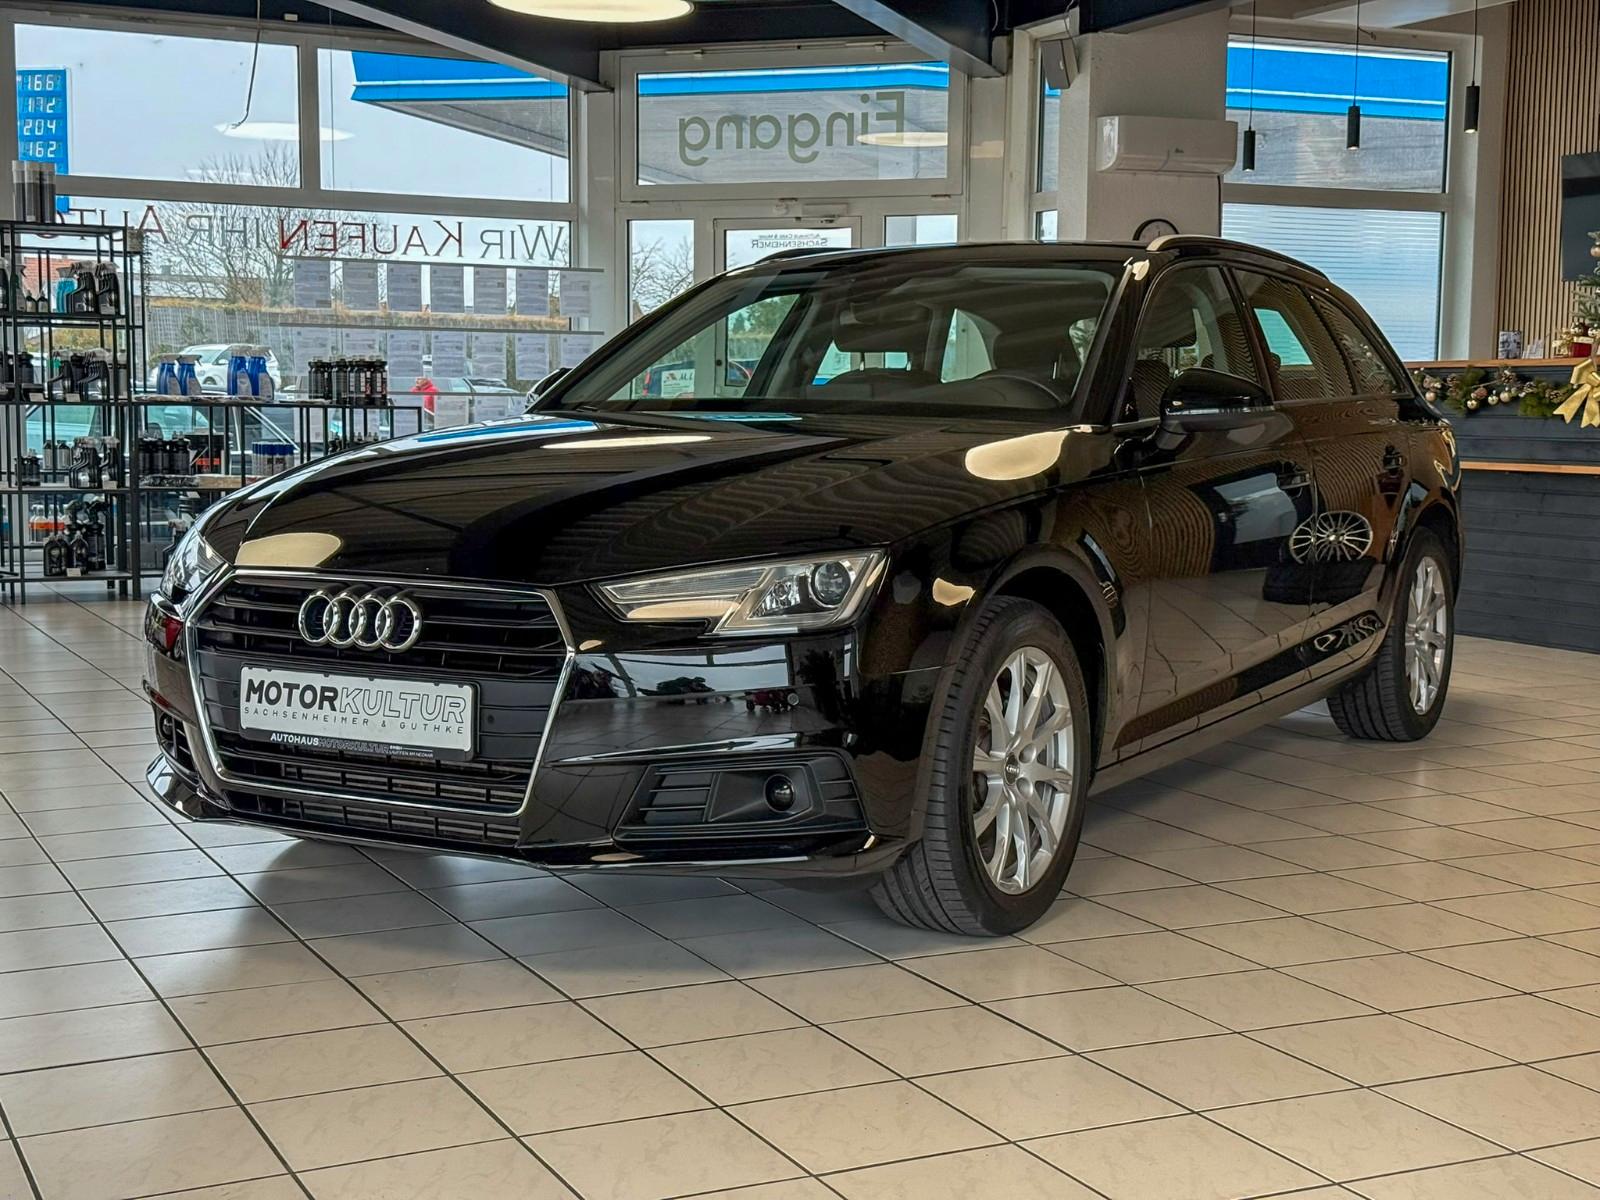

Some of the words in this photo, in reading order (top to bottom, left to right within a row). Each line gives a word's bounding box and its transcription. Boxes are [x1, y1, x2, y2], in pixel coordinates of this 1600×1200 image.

[23, 118, 57, 136] 204
[28, 140, 57, 158] 162
[245, 678, 467, 724] MOTORKULTUR
[243, 706, 370, 727] SACHSENHEIMER
[380, 720, 387, 728] &
[398, 721, 465, 735] GUTHKE
